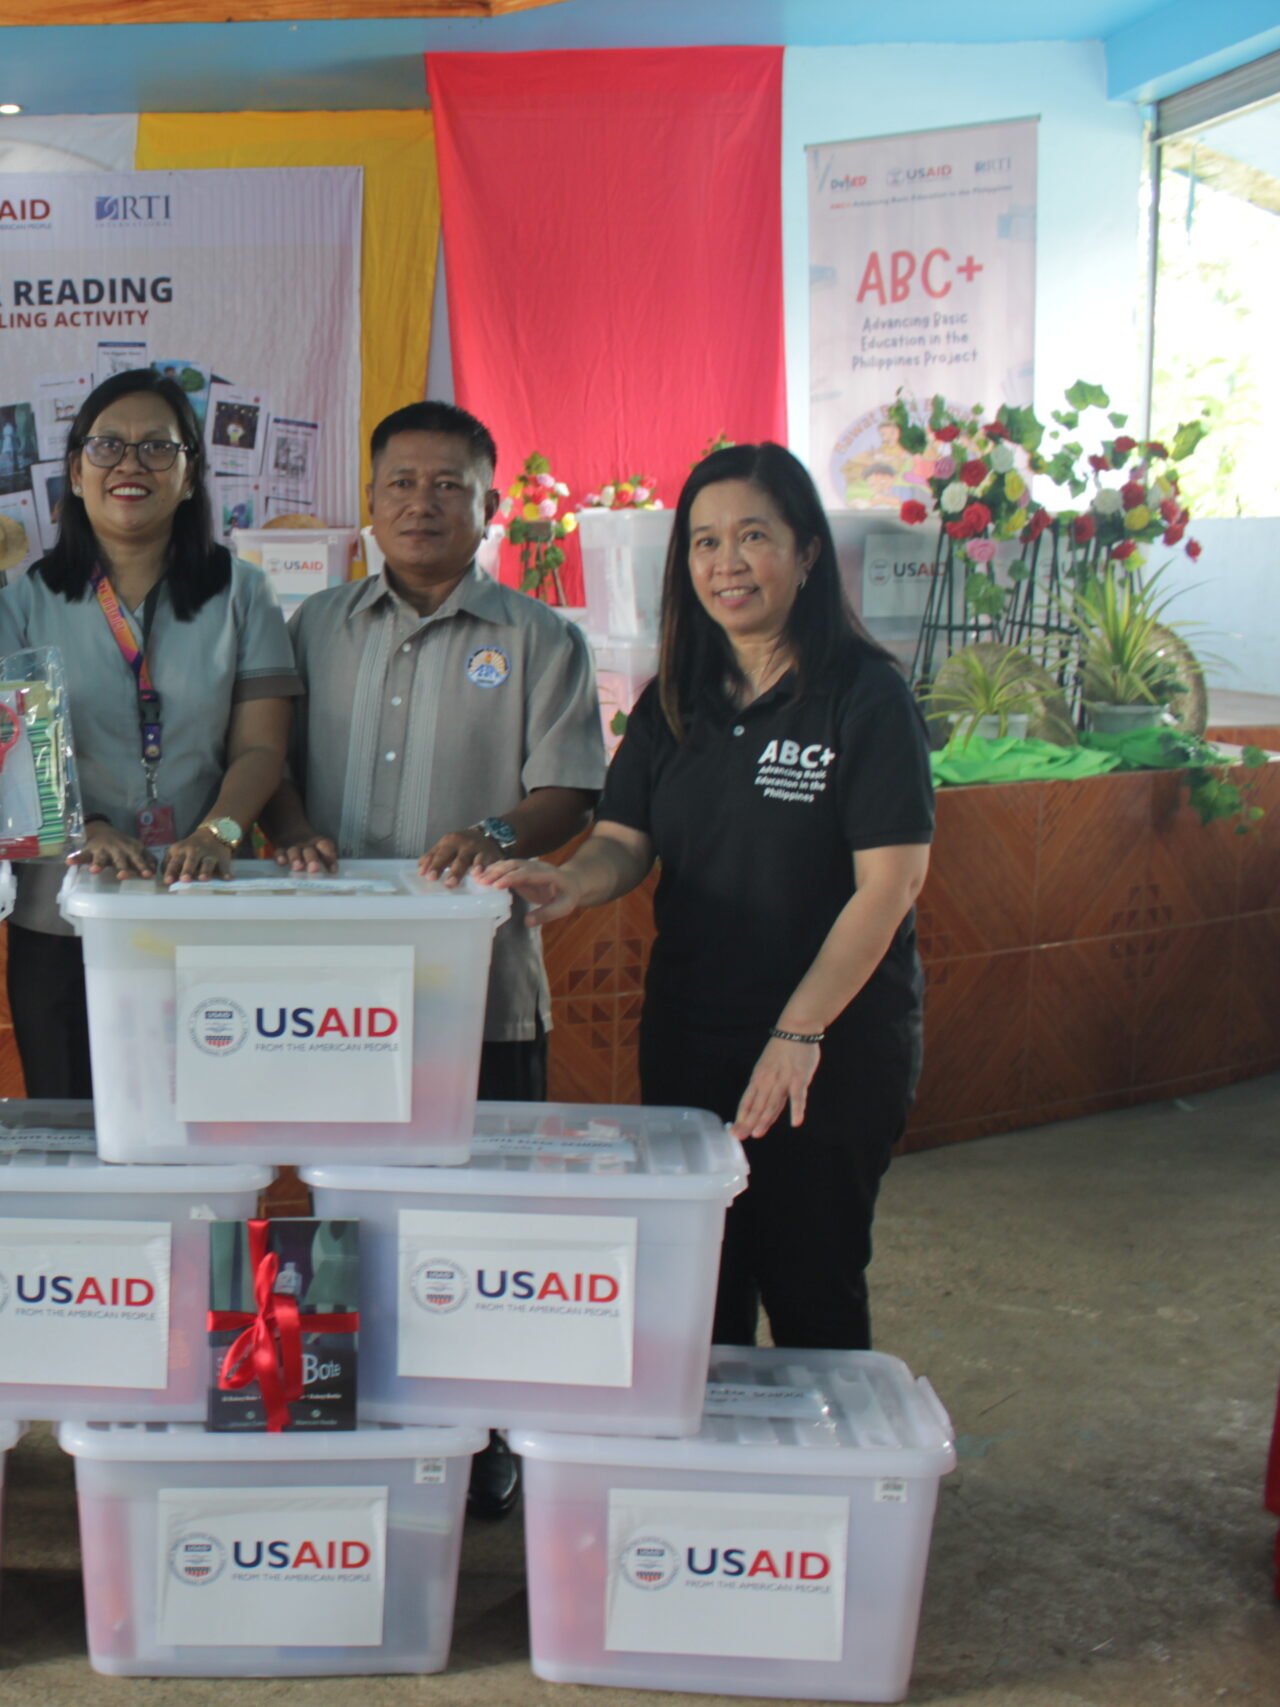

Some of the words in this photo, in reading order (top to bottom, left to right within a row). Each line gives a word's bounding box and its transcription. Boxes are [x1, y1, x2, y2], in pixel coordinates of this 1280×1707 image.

[906, 165, 952, 180] USAID
[123, 195, 172, 220] RTI
[856, 247, 984, 305] ABC+
[13, 276, 174, 306] READING
[55, 309, 149, 329] ACTIVITY
[862, 313, 929, 333] Advancing
[934, 311, 968, 328] Basic
[860, 333, 926, 352] Education
[930, 334, 941, 346] in
[945, 330, 969, 344] the
[851, 353, 921, 372] Philippines
[924, 349, 978, 367] Project
[284, 560, 324, 571] USAID
[757, 739, 835, 769] ABC+
[754, 775, 799, 790] Education
[758, 765, 802, 780] Advancing
[763, 787, 815, 803] Philippines
[256, 1007, 398, 1038] USAID
[255, 1043, 283, 1052] FROM
[286, 1043, 306, 1052] THE
[308, 1043, 361, 1052] AMERICAN
[364, 1043, 399, 1052] PEOPLE
[16, 1274, 154, 1307] USAID
[476, 1269, 619, 1303] USAID
[16, 1307, 44, 1316] FROM
[47, 1308, 66, 1317] THE
[68, 1310, 118, 1319] AMERICAN
[121, 1311, 156, 1321] PEOPLE
[475, 1303, 504, 1312] FROM
[508, 1303, 526, 1313] THE
[529, 1304, 582, 1315] AMERICAN
[584, 1307, 620, 1318] PEOPLE
[302, 1354, 341, 1385] Bote
[233, 1541, 371, 1569] USAID
[687, 1547, 831, 1580] USAID
[232, 1573, 260, 1582] FROM
[263, 1573, 282, 1582] THE
[284, 1573, 334, 1582] AMERICAN
[337, 1573, 371, 1582] PEOPLE
[685, 1580, 714, 1589] FROM
[717, 1580, 736, 1590] THE
[739, 1581, 792, 1592] AMERICAN
[795, 1583, 831, 1594] PEOPLE
